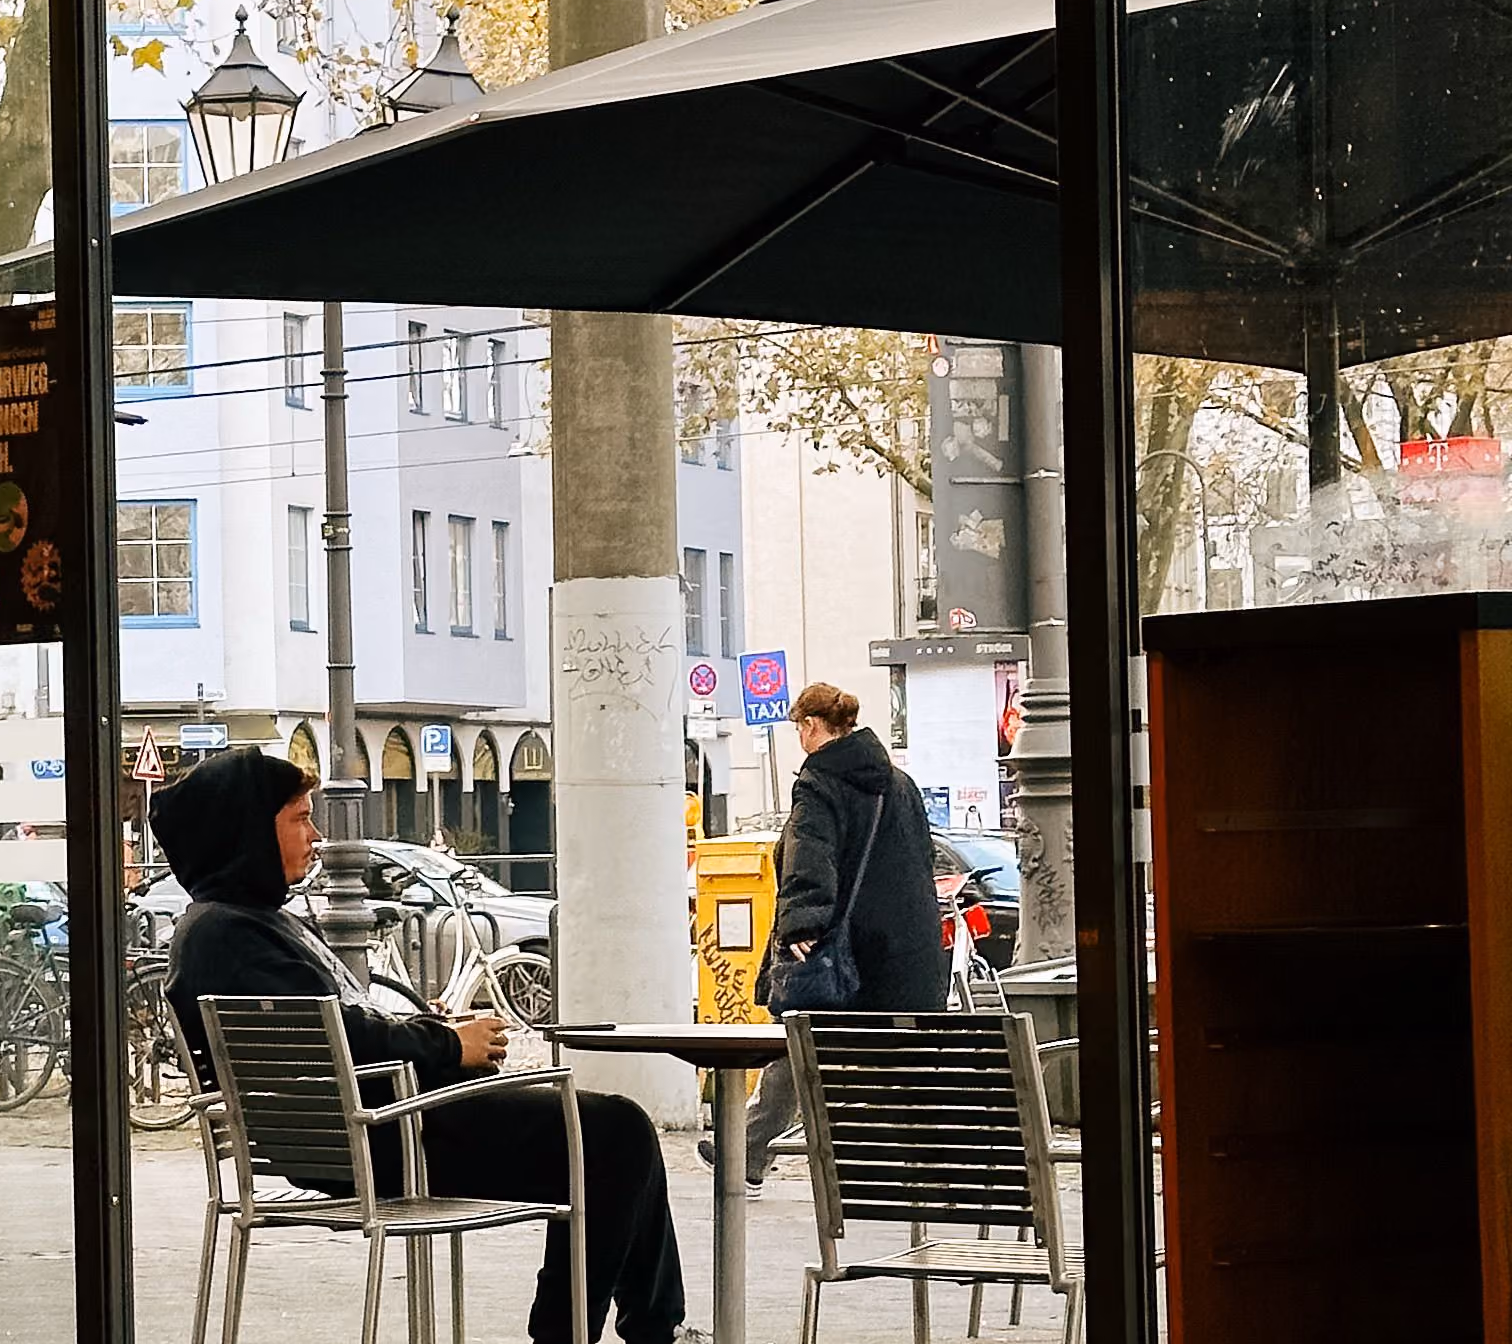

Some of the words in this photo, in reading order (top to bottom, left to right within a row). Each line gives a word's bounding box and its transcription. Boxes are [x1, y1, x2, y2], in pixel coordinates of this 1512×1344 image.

[1428, 441, 1448, 471] T
[747, 700, 787, 721] TAXI
[425, 729, 441, 753] P
